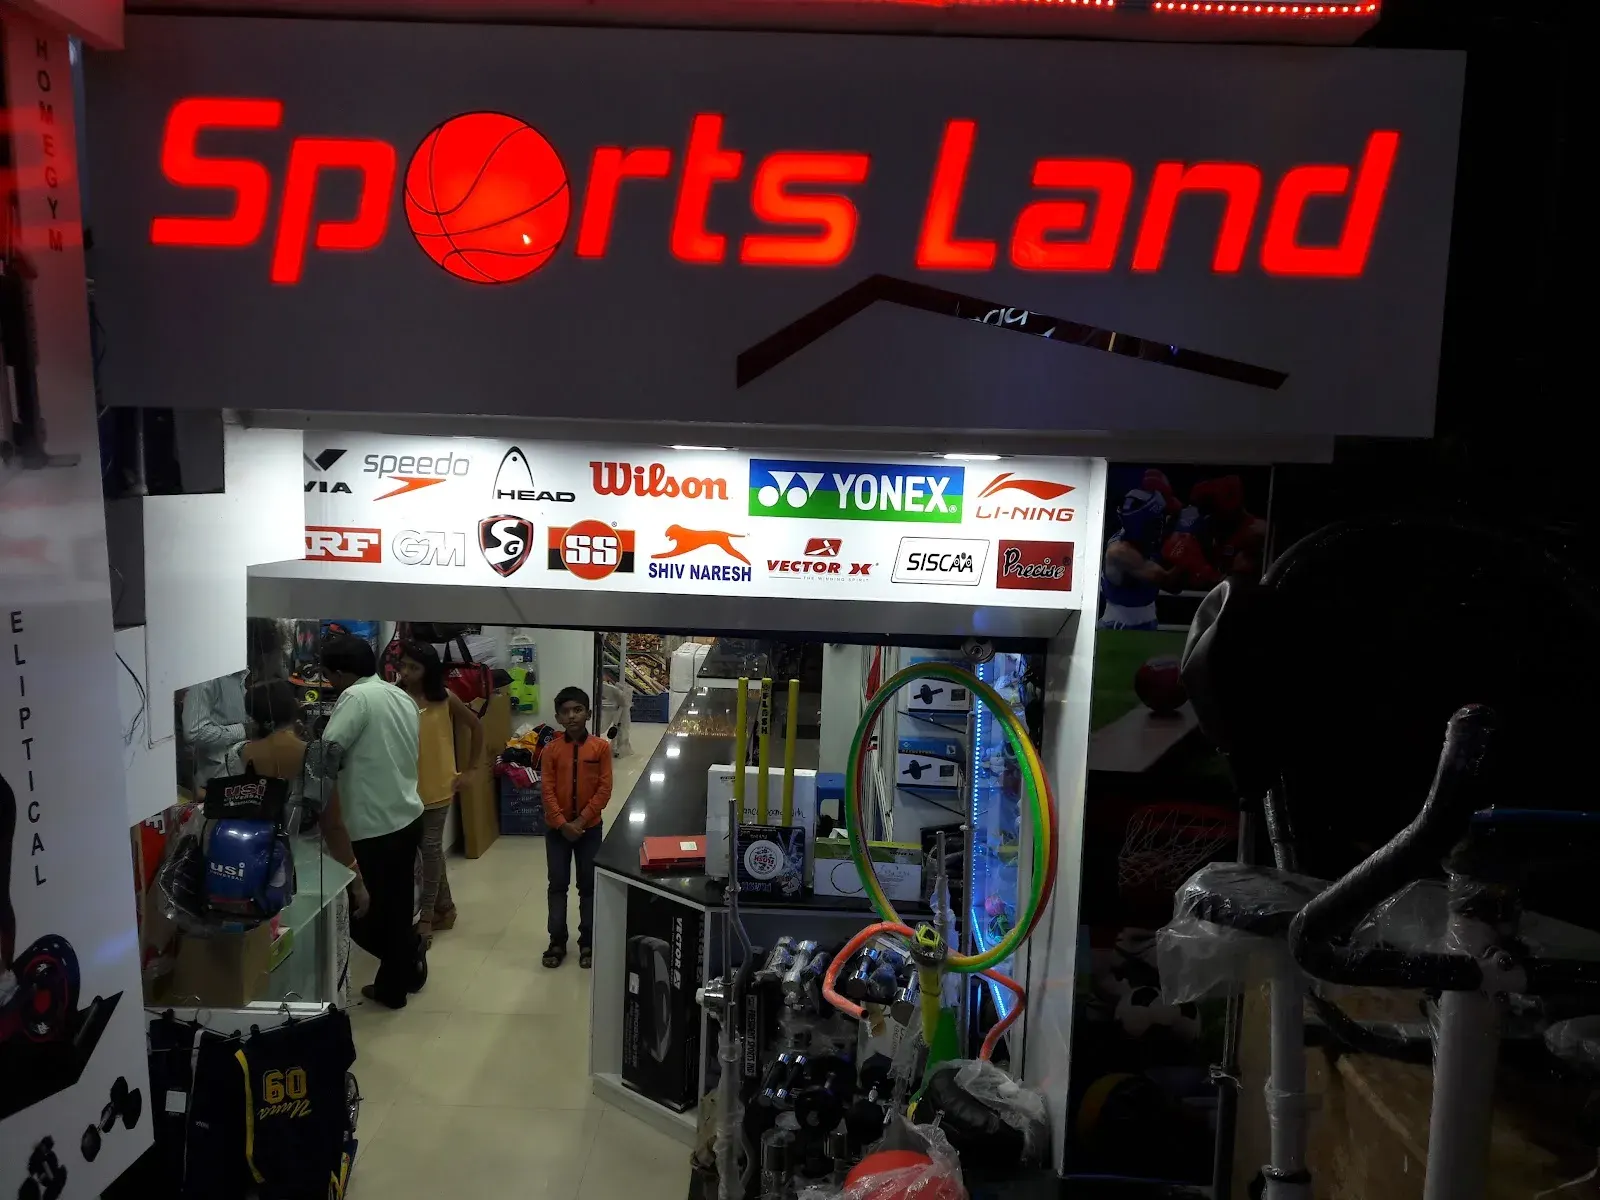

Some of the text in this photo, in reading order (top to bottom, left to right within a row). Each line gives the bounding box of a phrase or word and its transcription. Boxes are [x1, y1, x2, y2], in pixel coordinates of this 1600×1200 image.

[150, 98, 1400, 284] Sports Land
[364, 452, 470, 479] speedo
[589, 461, 729, 500] Wilson
[497, 489, 576, 503] HEAD
[832, 474, 950, 514] YONEX
[975, 505, 1075, 522] LI-NING
[391, 529, 466, 567] GM
[565, 534, 618, 566] SS
[1003, 547, 1066, 580] Precise
[648, 562, 752, 582] SHIV NARESH
[766, 559, 874, 575] VECTOR X
[10, 610, 46, 886] ELIPTICAL
[674, 917, 683, 970] VECTOR
